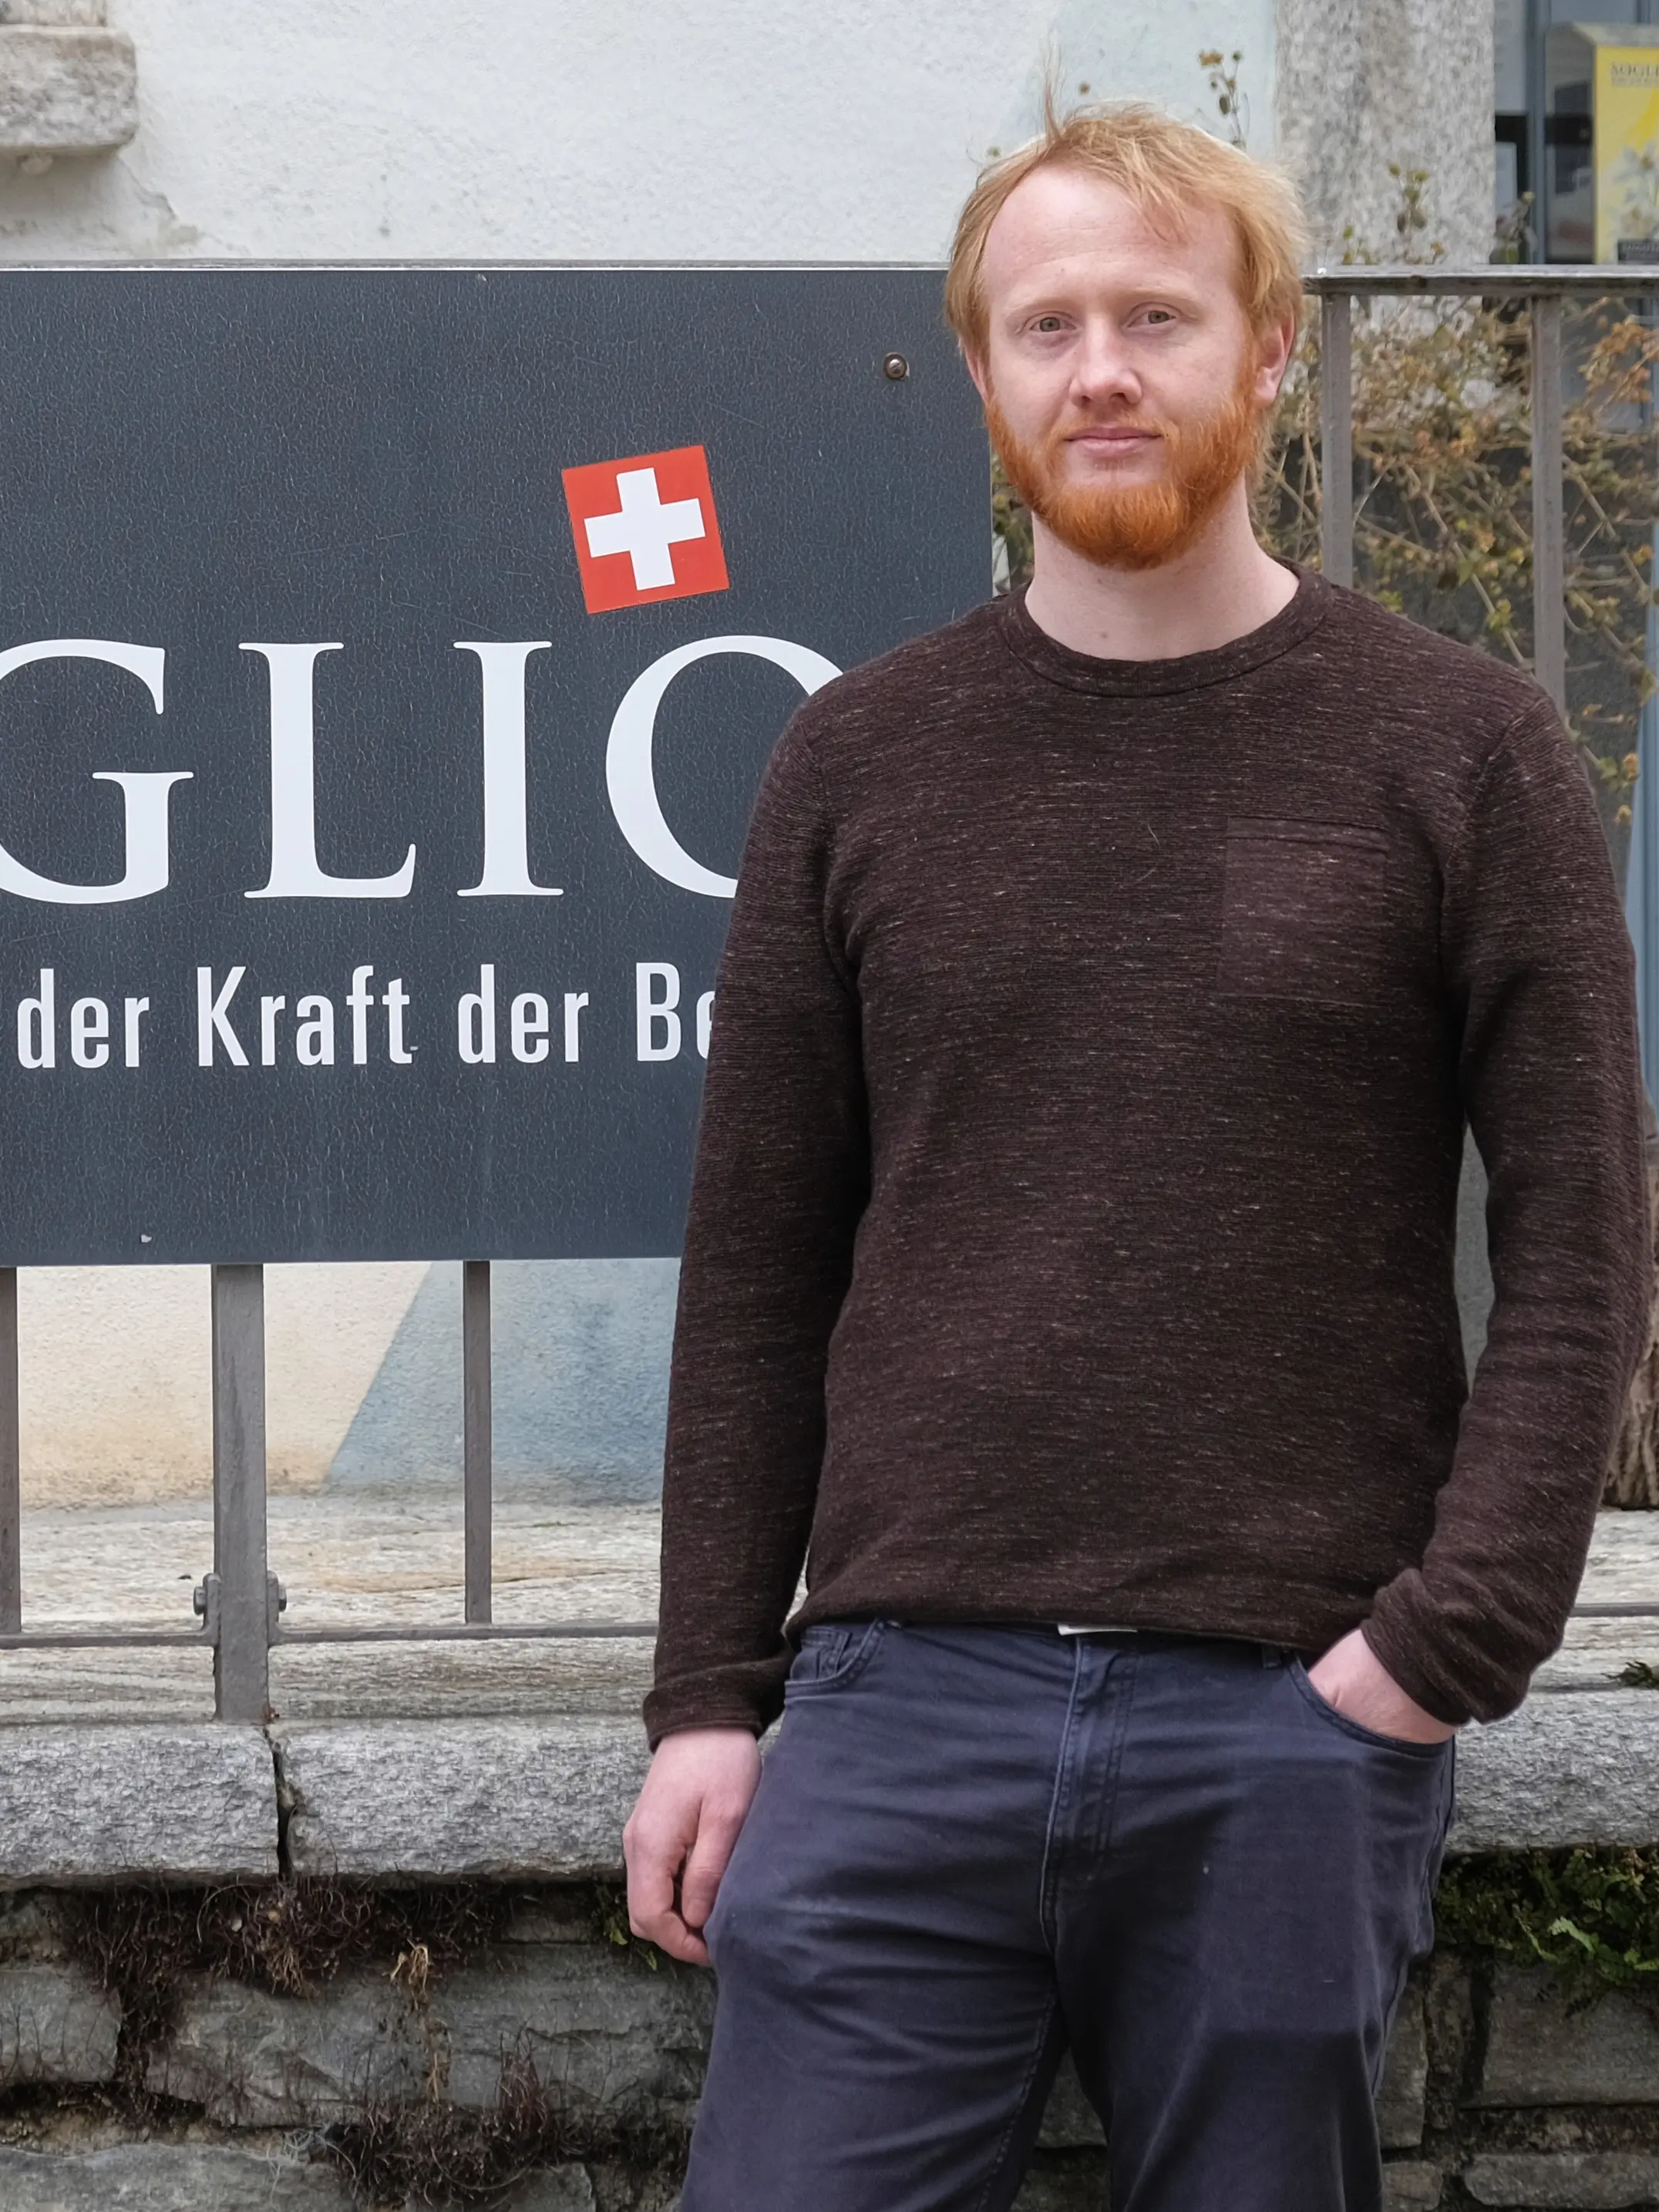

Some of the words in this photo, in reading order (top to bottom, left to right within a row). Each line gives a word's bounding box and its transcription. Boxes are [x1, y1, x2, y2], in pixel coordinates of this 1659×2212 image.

[0, 635, 843, 904] GLIO
[17, 968, 150, 1069] der
[197, 965, 413, 1067] Kraft
[458, 964, 589, 1064] der
